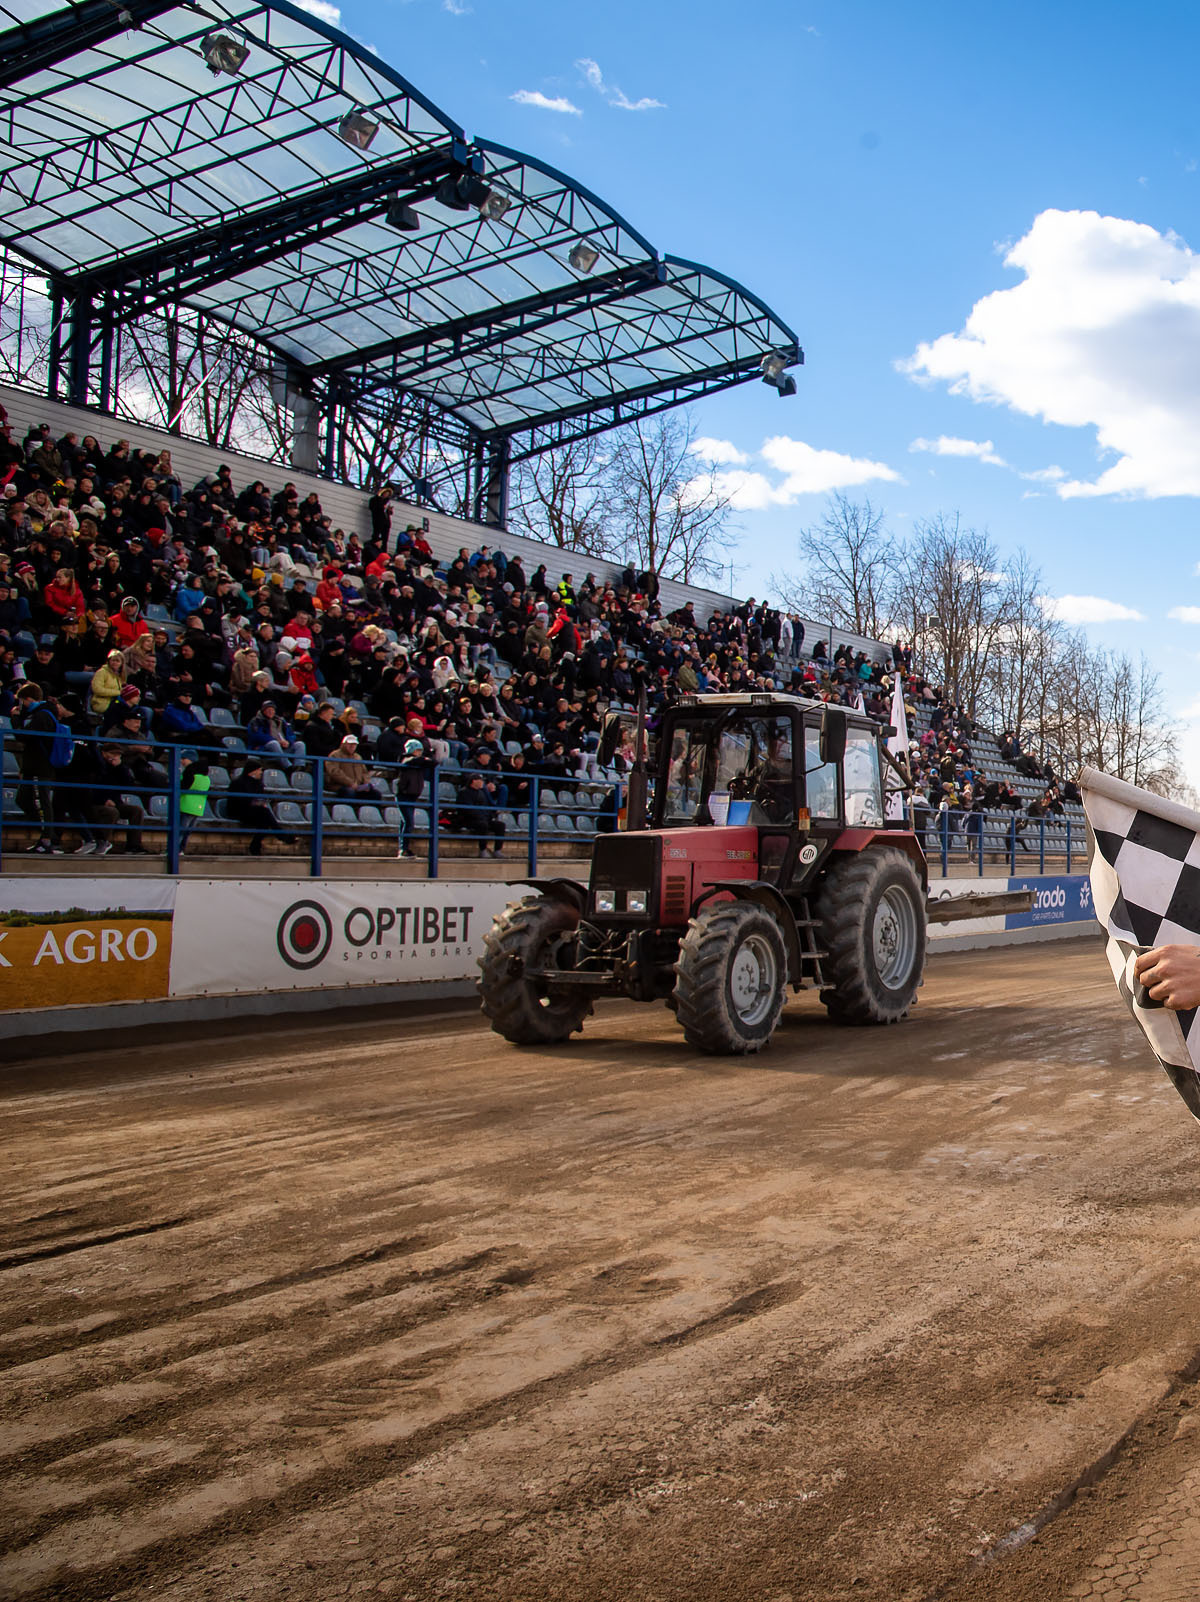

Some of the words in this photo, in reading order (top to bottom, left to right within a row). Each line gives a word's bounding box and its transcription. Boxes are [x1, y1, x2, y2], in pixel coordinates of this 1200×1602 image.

[344, 907, 474, 947] OPTIBET
[33, 928, 158, 966] AGRO
[343, 950, 418, 961] SPORTA
[430, 946, 473, 957] BĀRS
